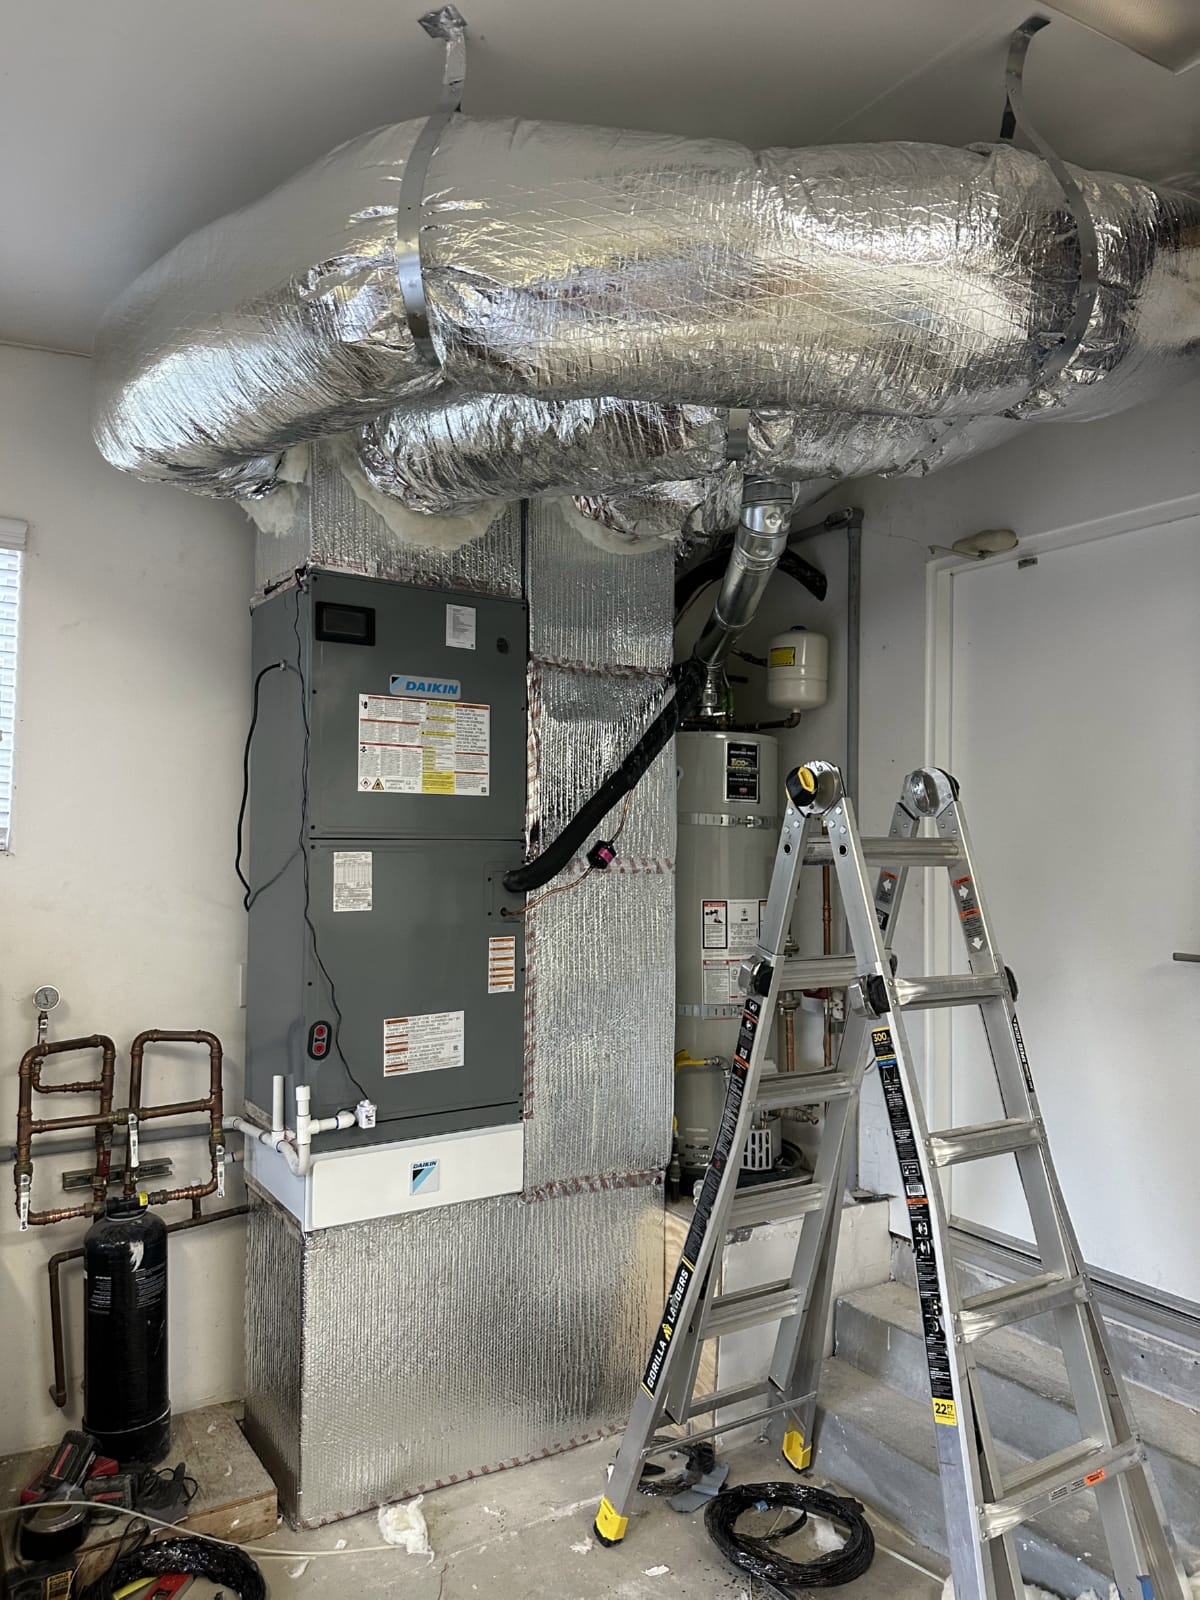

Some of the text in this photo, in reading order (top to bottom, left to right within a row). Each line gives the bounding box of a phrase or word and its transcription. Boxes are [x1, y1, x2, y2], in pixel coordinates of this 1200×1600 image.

[405, 681, 458, 694] DAIKIN
[873, 1032, 887, 1042] 300
[413, 1161, 437, 1169] DAIKIN
[647, 1269, 689, 1389] GORILLA LADDERS
[935, 1403, 947, 1415] 22
